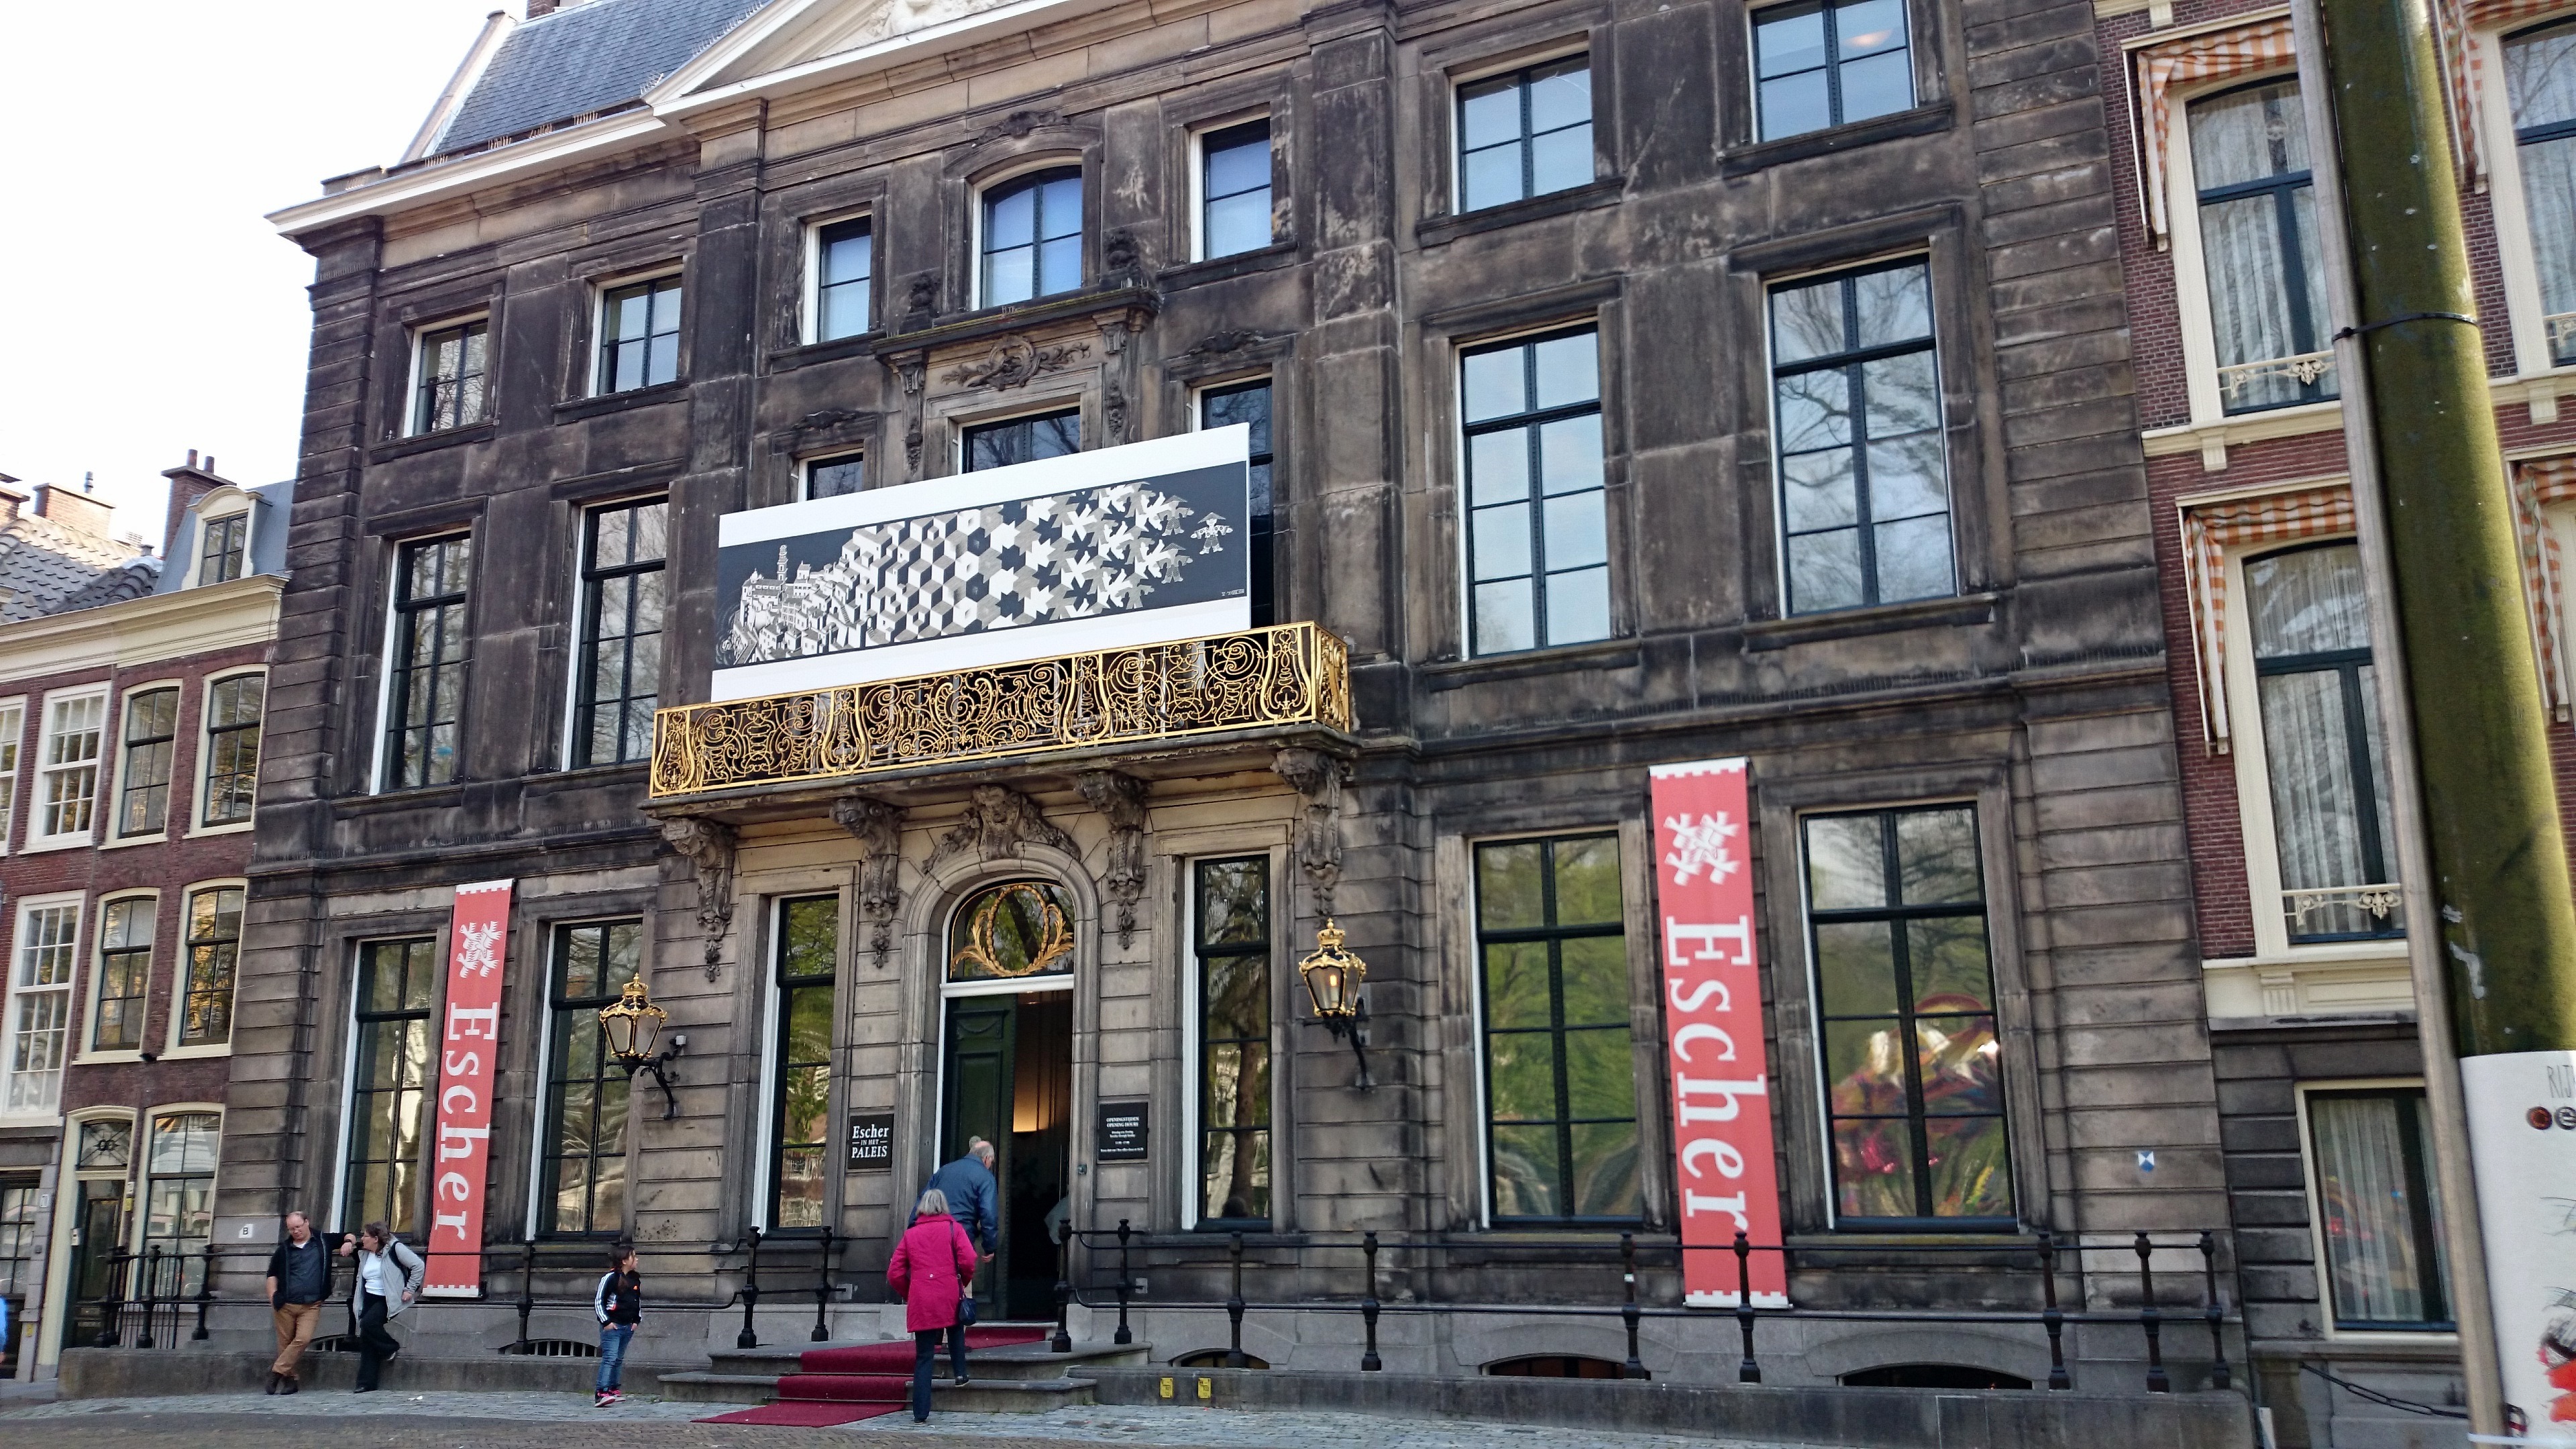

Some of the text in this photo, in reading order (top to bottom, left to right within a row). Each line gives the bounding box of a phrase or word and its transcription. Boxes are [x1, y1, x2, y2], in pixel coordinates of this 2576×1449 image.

[1666, 916, 1766, 1231] Escher
[435, 1002, 498, 1240] Escher
[852, 1124, 890, 1139] Escher
[851, 1145, 888, 1159] PALEIS
[243, 1227, 249, 1235] B
